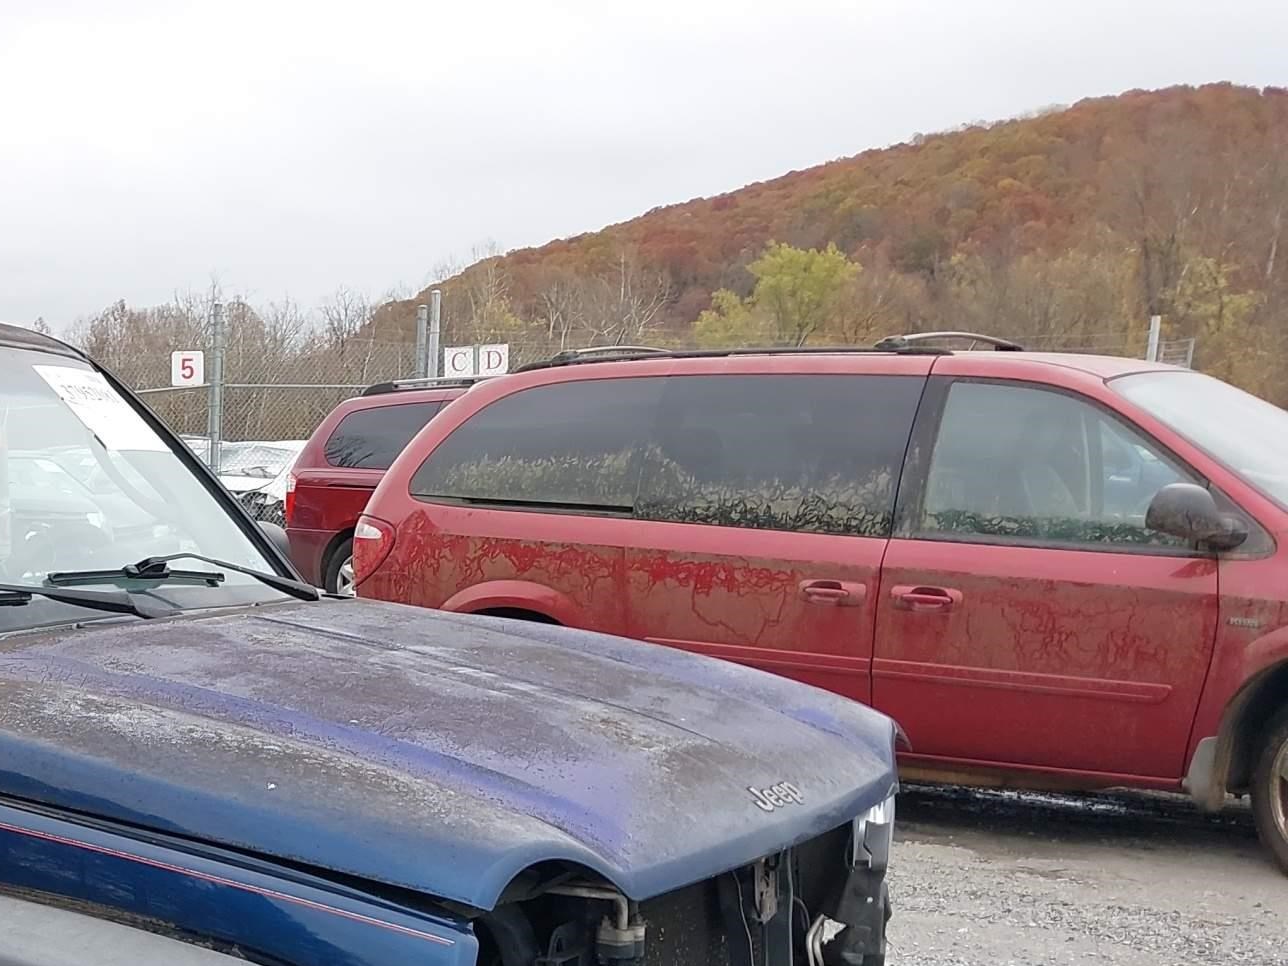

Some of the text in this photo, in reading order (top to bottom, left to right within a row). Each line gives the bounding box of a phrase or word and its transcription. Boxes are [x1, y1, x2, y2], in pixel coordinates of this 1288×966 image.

[181, 358, 194, 379] 5
[452, 352, 467, 371] C
[486, 350, 502, 369] D
[746, 781, 805, 813] Jeep
